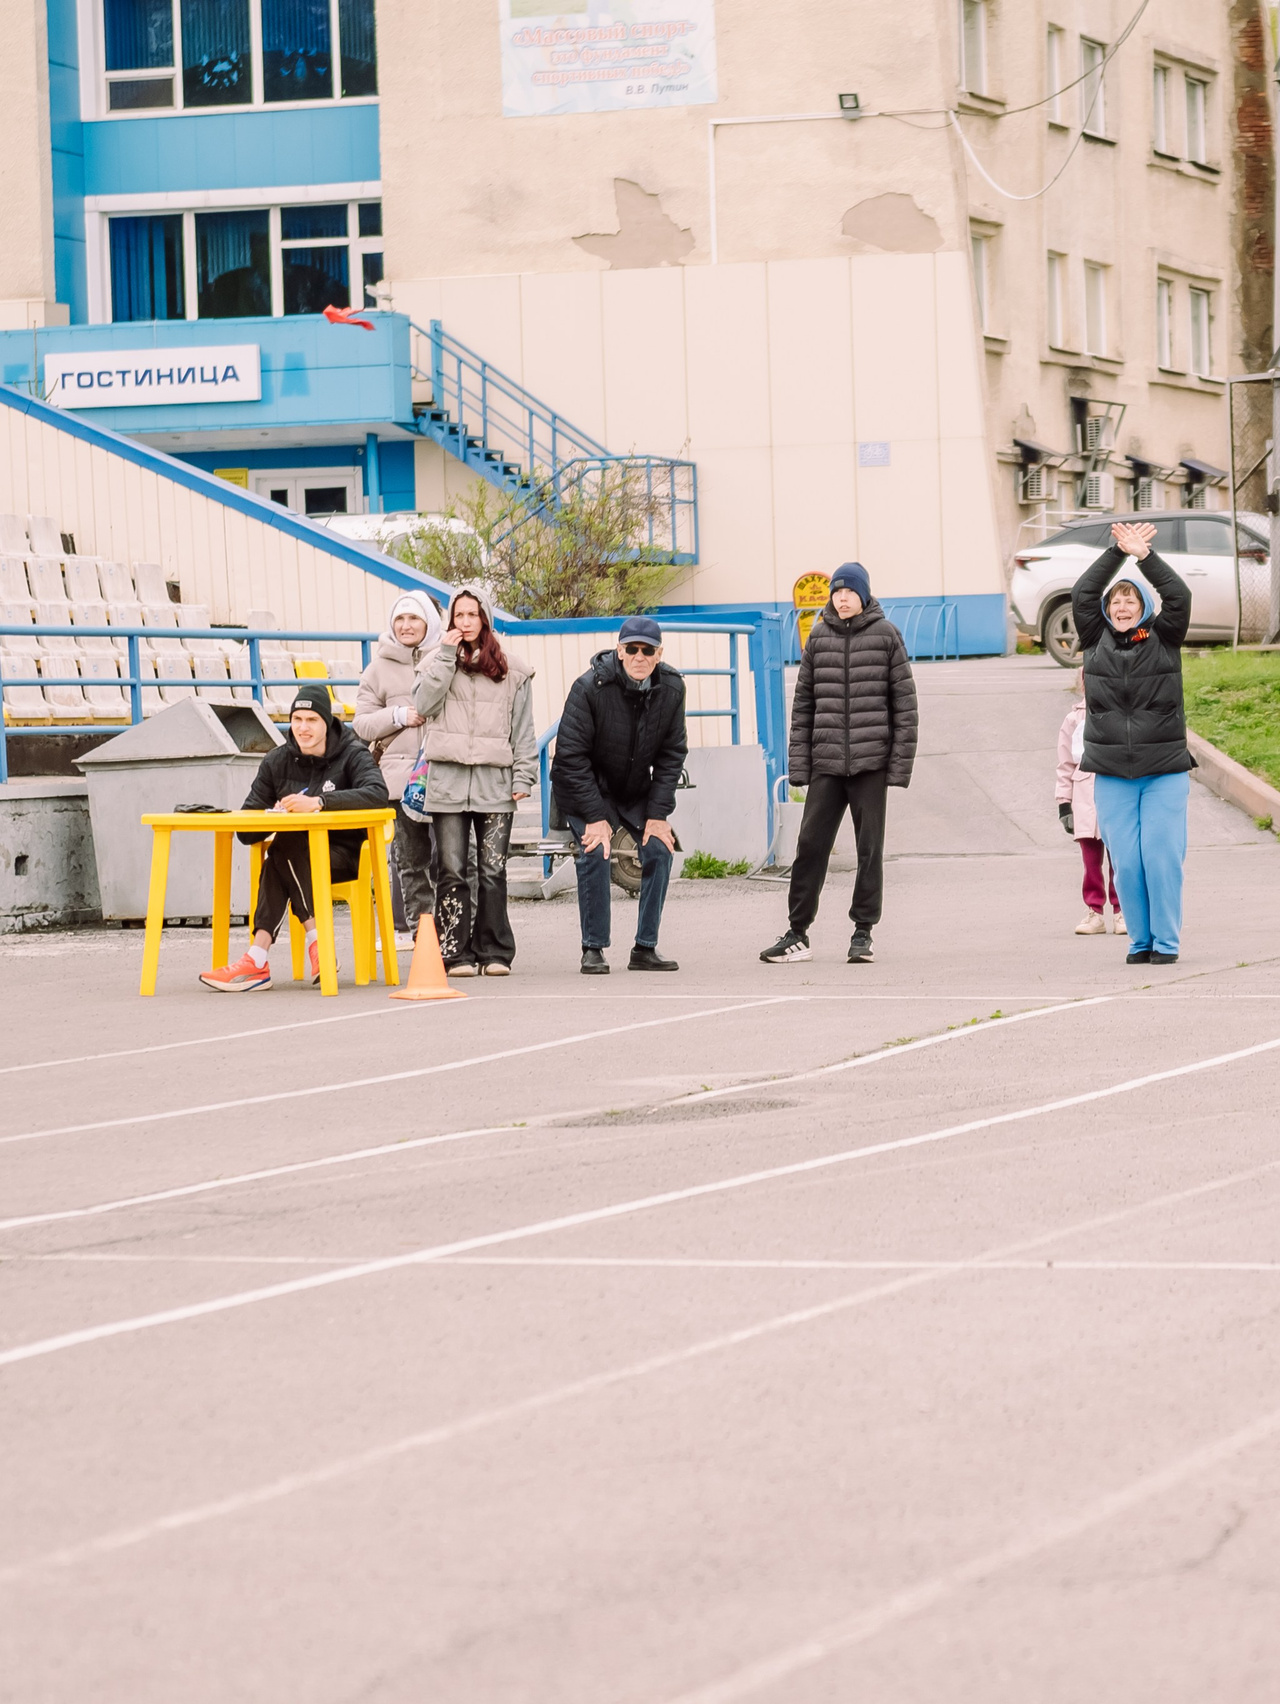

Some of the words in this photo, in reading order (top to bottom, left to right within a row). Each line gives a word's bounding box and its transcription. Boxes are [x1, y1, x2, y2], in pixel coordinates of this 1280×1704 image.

[513, 23, 627, 46] «Массовый
[580, 44, 669, 64] фундамент
[532, 66, 627, 85] спортивных
[651, 83, 689, 95] Путин
[61, 365, 240, 389] ГОСТИНИЦА
[797, 575, 831, 590] ШАХТЕ
